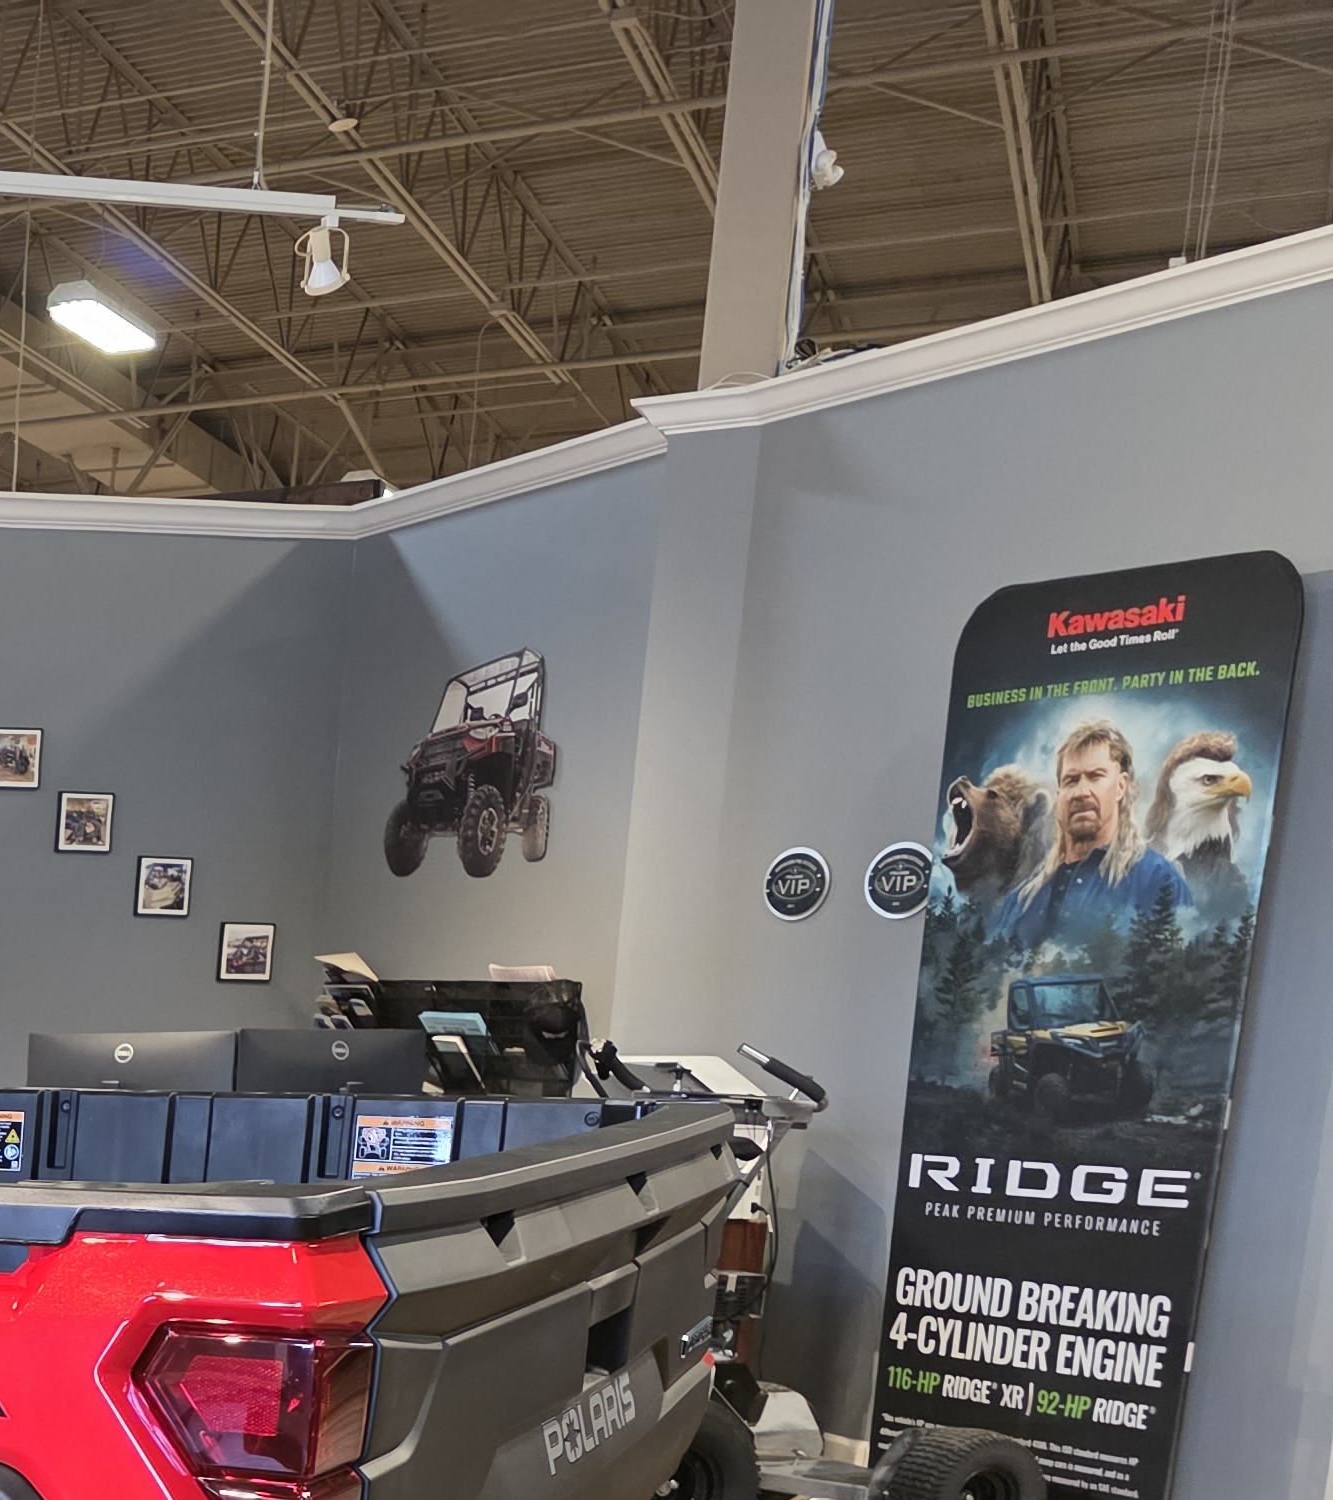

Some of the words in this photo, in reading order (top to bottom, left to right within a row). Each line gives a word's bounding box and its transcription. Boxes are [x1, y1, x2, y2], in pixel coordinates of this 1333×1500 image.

[1047, 596, 1186, 638] Kawasaki
[1050, 643, 1068, 654] Let
[1070, 640, 1087, 652] the
[1088, 635, 1117, 650] Good
[1119, 633, 1151, 646] Times
[966, 686, 1026, 709] BUSINESS
[1029, 687, 1044, 701] IN
[1047, 683, 1070, 698] THE
[1073, 677, 1117, 696] FRONT.
[1122, 671, 1165, 690] PARTY
[1169, 669, 1184, 685] IN
[1188, 666, 1214, 682] THE
[1218, 661, 1260, 680] BACK.
[778, 878, 810, 895] VIP
[881, 875, 917, 892] VIP
[924, 1202, 960, 1219] PEAK
[967, 1204, 1036, 1226] PREMIUM
[1044, 1211, 1161, 1237] PERFORMANCE
[895, 1266, 1013, 1319] GROUND
[1017, 1281, 1172, 1339] BREAKING
[888, 1311, 1048, 1373] 4-CYLINDER
[1055, 1334, 1167, 1389] ENGINE
[887, 1365, 941, 1395] 116-HP
[1000, 1384, 1024, 1410] XR
[1036, 1389, 1092, 1420] 92-HP
[543, 1371, 635, 1475] POLARIS
